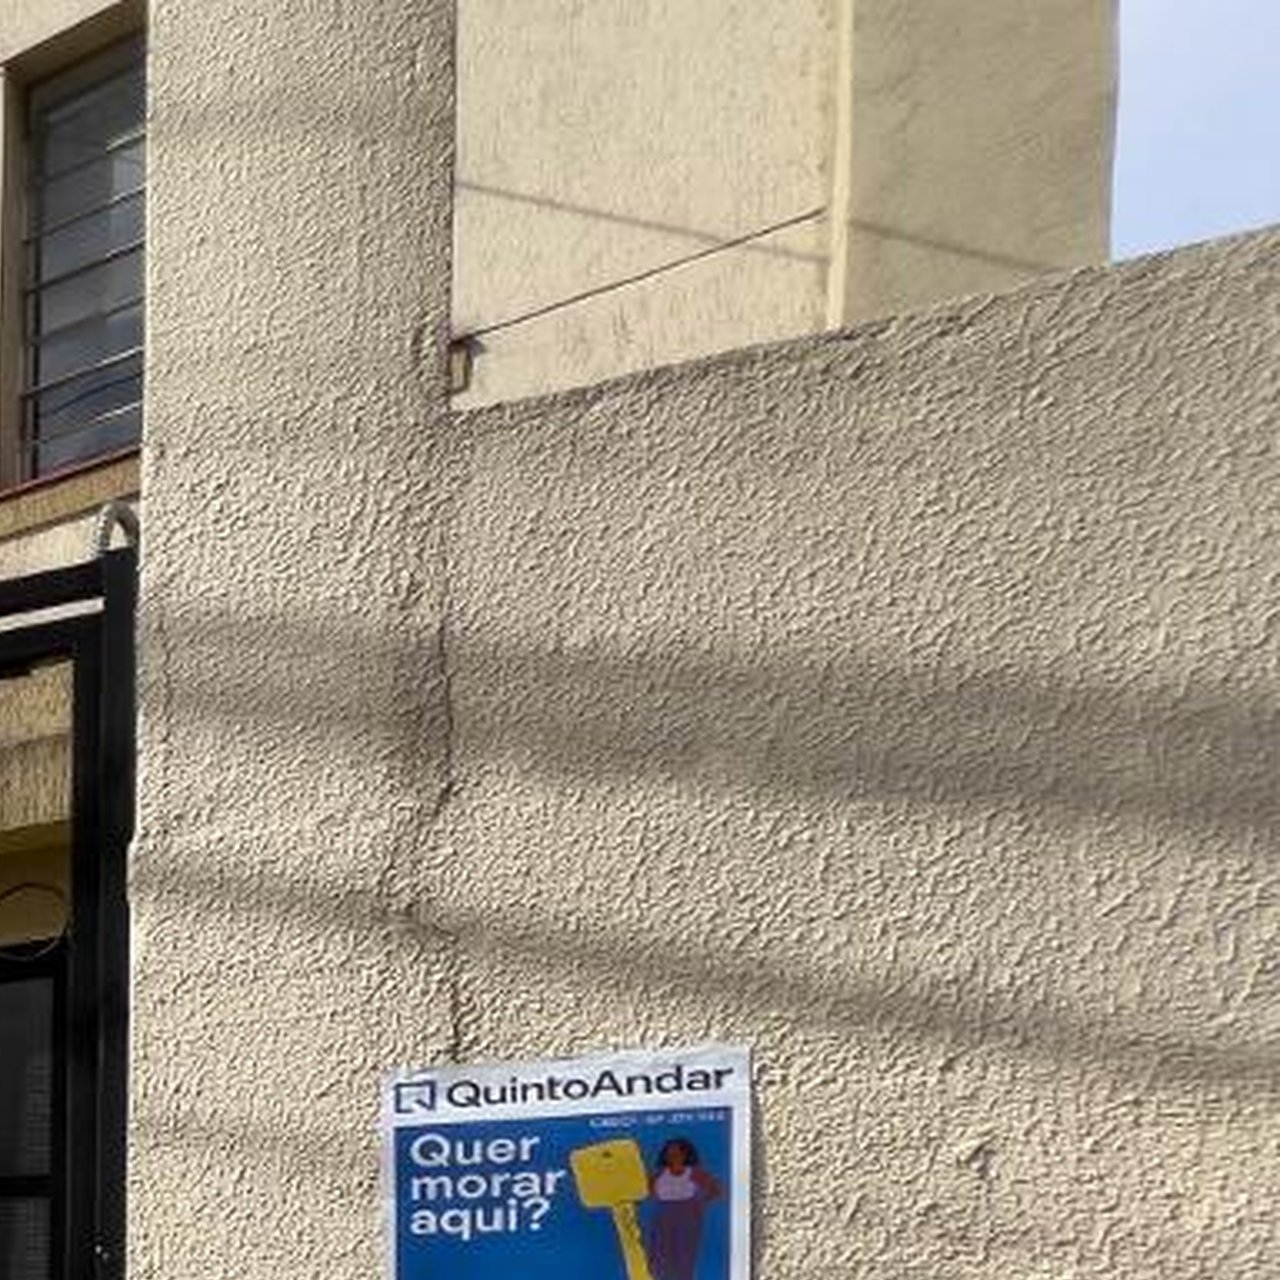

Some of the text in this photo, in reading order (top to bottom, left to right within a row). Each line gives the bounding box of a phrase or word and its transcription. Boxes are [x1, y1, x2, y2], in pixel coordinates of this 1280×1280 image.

[446, 1065, 734, 1109] QuintoAndar
[410, 1133, 540, 1167] Quer
[410, 1168, 567, 1200] morar
[410, 1198, 551, 1240] aqui?
